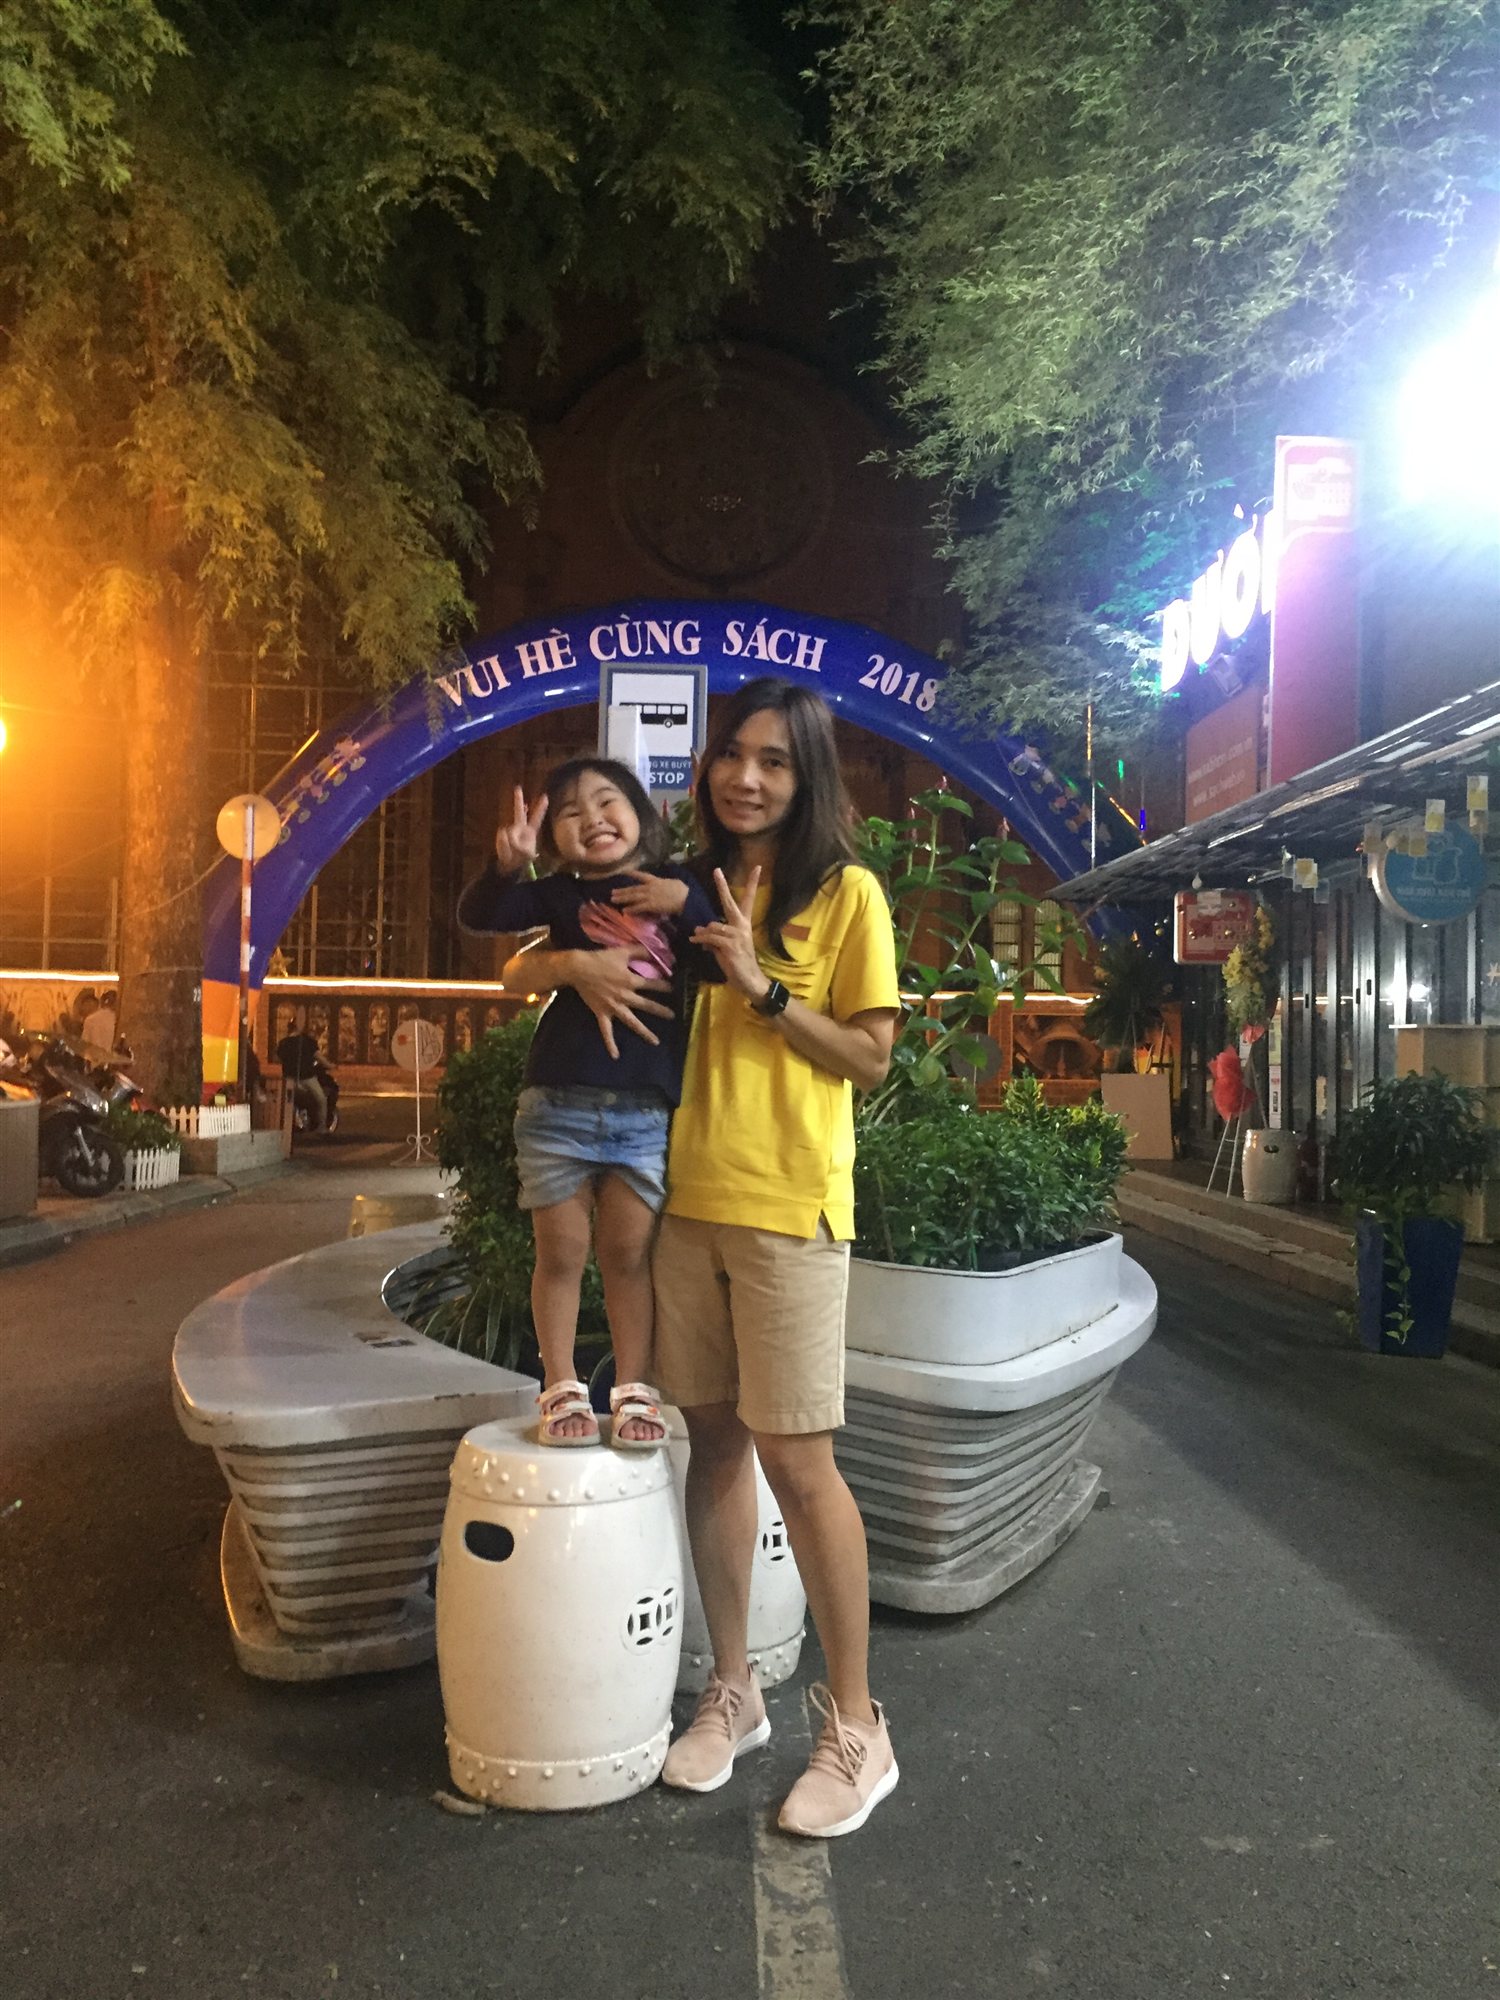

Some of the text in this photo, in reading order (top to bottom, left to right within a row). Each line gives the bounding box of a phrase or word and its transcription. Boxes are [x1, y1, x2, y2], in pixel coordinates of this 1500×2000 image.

[434, 613, 938, 712] VUI HÈ CÙNG SÁCH 2018
[649, 771, 685, 784] STOP
